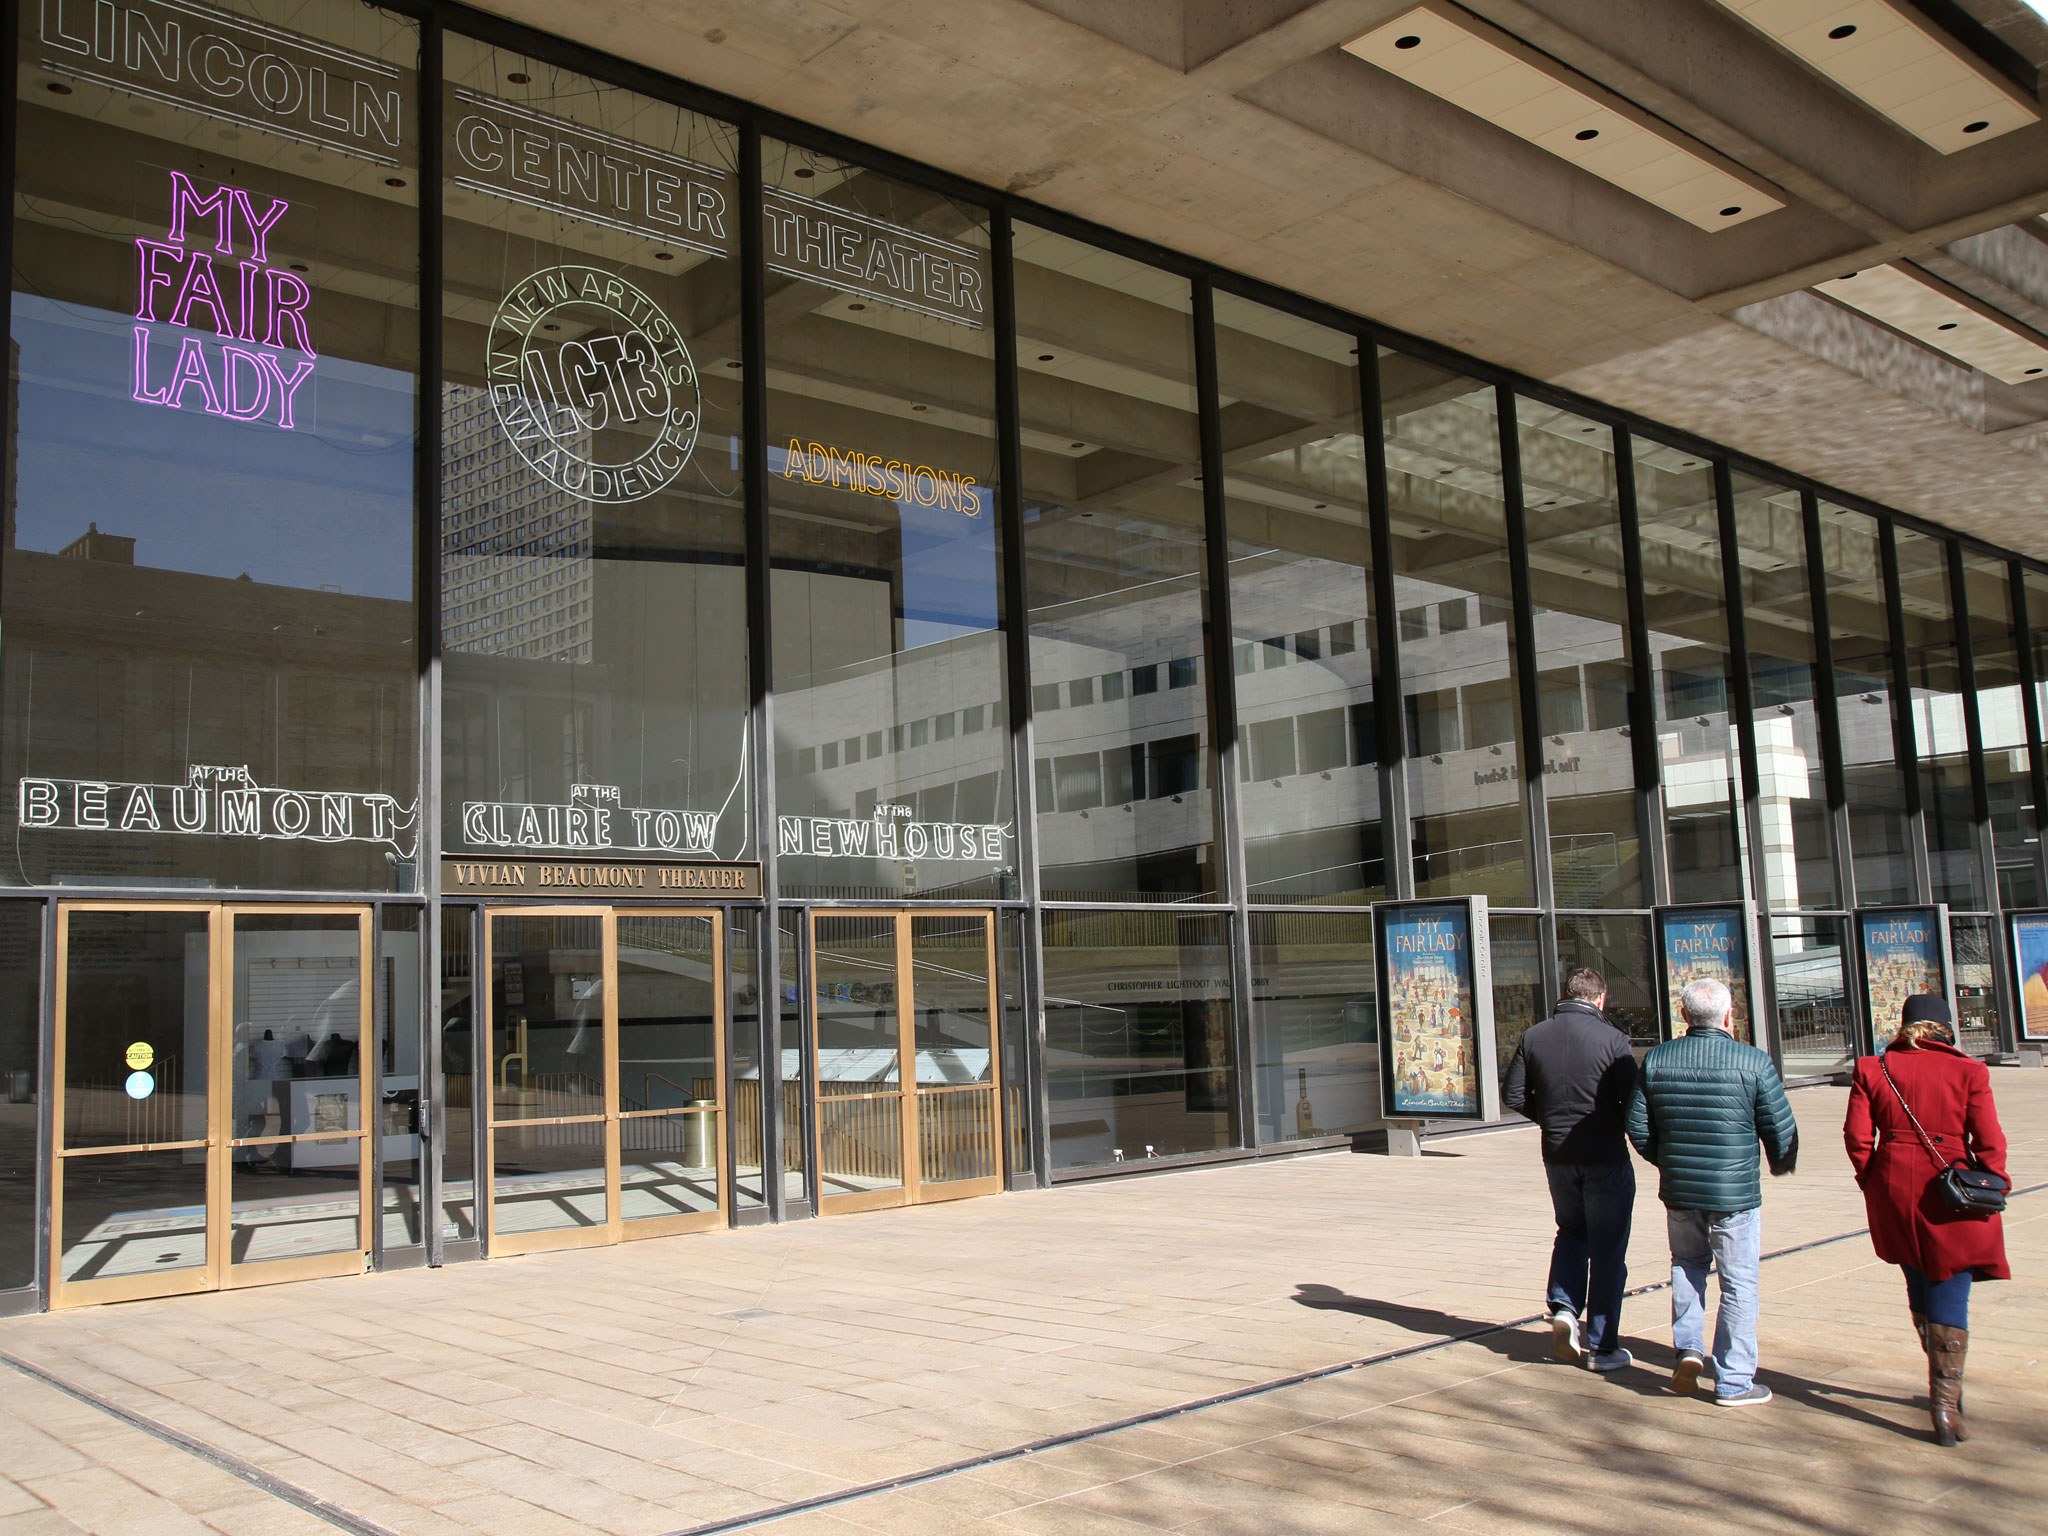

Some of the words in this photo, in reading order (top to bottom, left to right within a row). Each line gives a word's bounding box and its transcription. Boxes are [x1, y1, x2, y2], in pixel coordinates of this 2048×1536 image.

[40, 0, 400, 147] LINCOLN
[456, 115, 726, 239] CENTER
[763, 205, 983, 313] THEATER
[168, 171, 288, 263] MY
[135, 238, 316, 359] FAIR
[501, 272, 568, 336] NEW
[580, 273, 693, 386] ARTISTS
[133, 326, 315, 428] LADY
[525, 330, 671, 437] LCT3
[491, 352, 541, 441] NEW
[533, 407, 696, 497] AUDIENCES
[785, 438, 981, 517] ADMISSIONS
[21, 780, 393, 838] BEAUMONT
[573, 786, 589, 798] AT
[592, 786, 619, 799] THE
[464, 804, 612, 846] CLAIRE
[632, 811, 718, 850] TOW
[779, 817, 1002, 859] NEWHOUSE
[453, 864, 527, 886] VIVIAN
[538, 865, 647, 888] BEAUMONT
[658, 868, 747, 889] THEATER
[1396, 934, 1427, 953] FAIR
[1428, 932, 1464, 952] LADY
[1418, 917, 1441, 934] MY
[1674, 938, 1703, 953] FAIR
[1705, 937, 1737, 953] LADY
[1694, 923, 1717, 938] MY
[1871, 931, 1898, 944] FAIR
[1900, 930, 1930, 944] LADY
[1889, 919, 1911, 931] MY
[1107, 980, 1162, 992] CHRISTOPHER
[1167, 979, 1210, 989] LIGHTFOOT
[1251, 977, 1270, 987] OBBY
